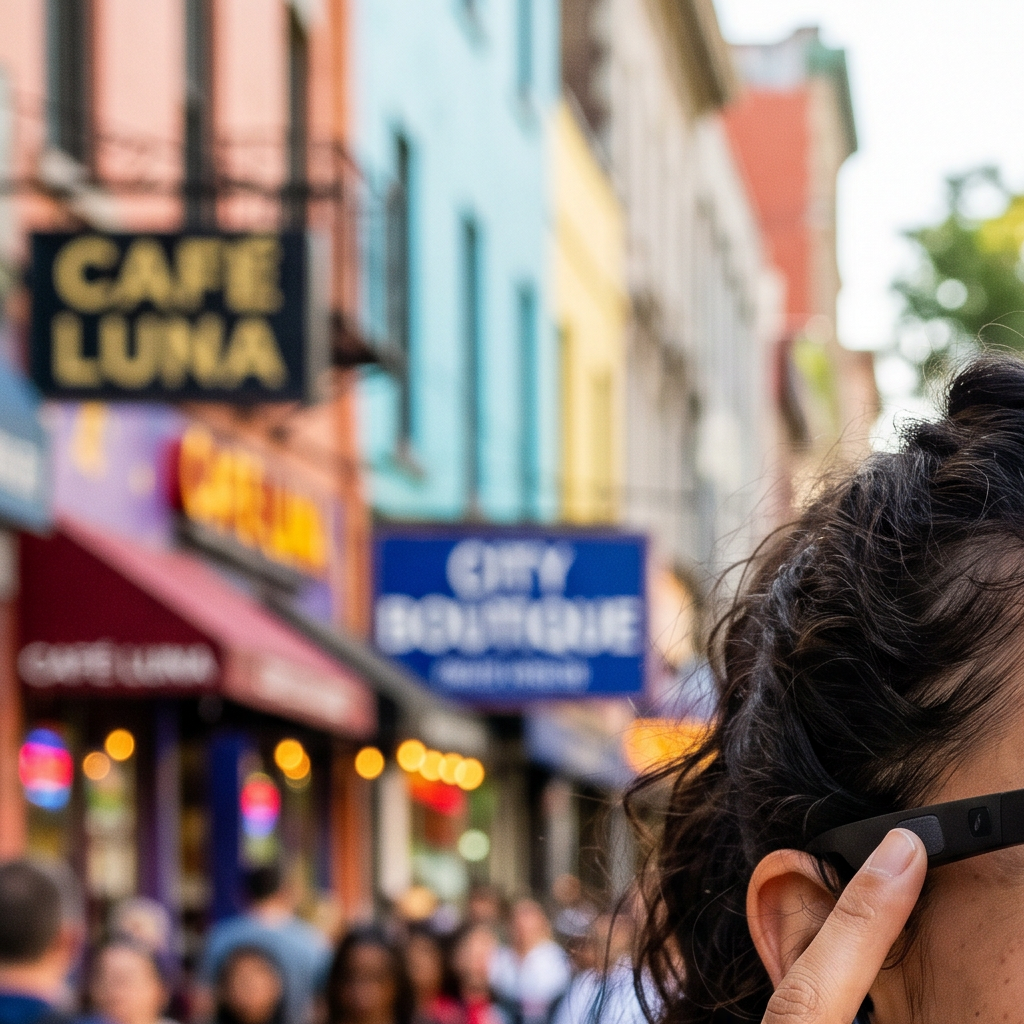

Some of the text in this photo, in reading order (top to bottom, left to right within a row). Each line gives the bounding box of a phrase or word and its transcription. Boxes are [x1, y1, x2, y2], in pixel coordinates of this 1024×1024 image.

[52, 312, 287, 389] LUNA
[447, 540, 574, 599] CITY
[377, 595, 640, 656] BOUTIQUE
